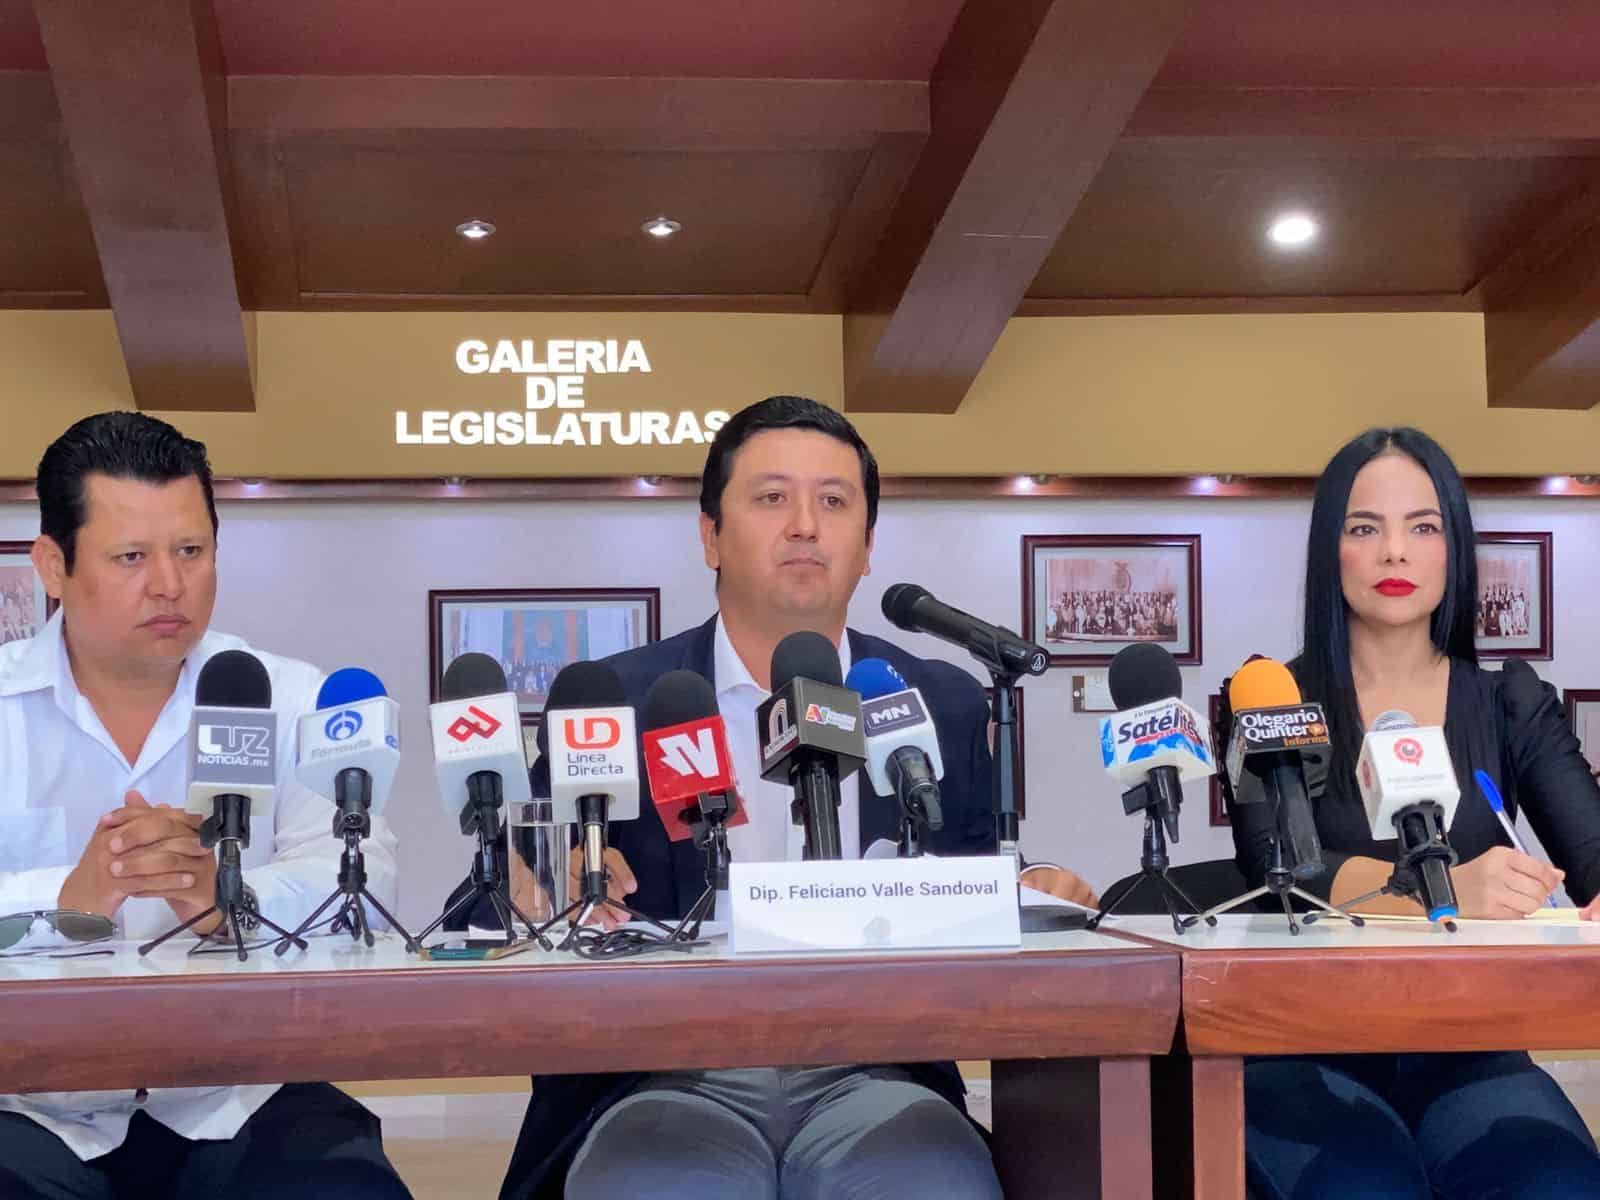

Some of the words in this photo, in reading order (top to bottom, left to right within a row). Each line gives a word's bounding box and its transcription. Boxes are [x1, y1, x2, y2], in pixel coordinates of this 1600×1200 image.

[455, 339, 651, 374] GALERIA
[526, 375, 585, 409] DE
[395, 411, 730, 446] LEGISLATURAS
[870, 703, 911, 724] MN
[1241, 709, 1319, 728] Olegario
[198, 724, 270, 757] LUZ
[567, 764, 624, 777] Directa
[749, 885, 783, 903] Dip.
[789, 883, 867, 900] Feliciano
[872, 881, 915, 897] Valle
[919, 880, 999, 896] Sandoval
